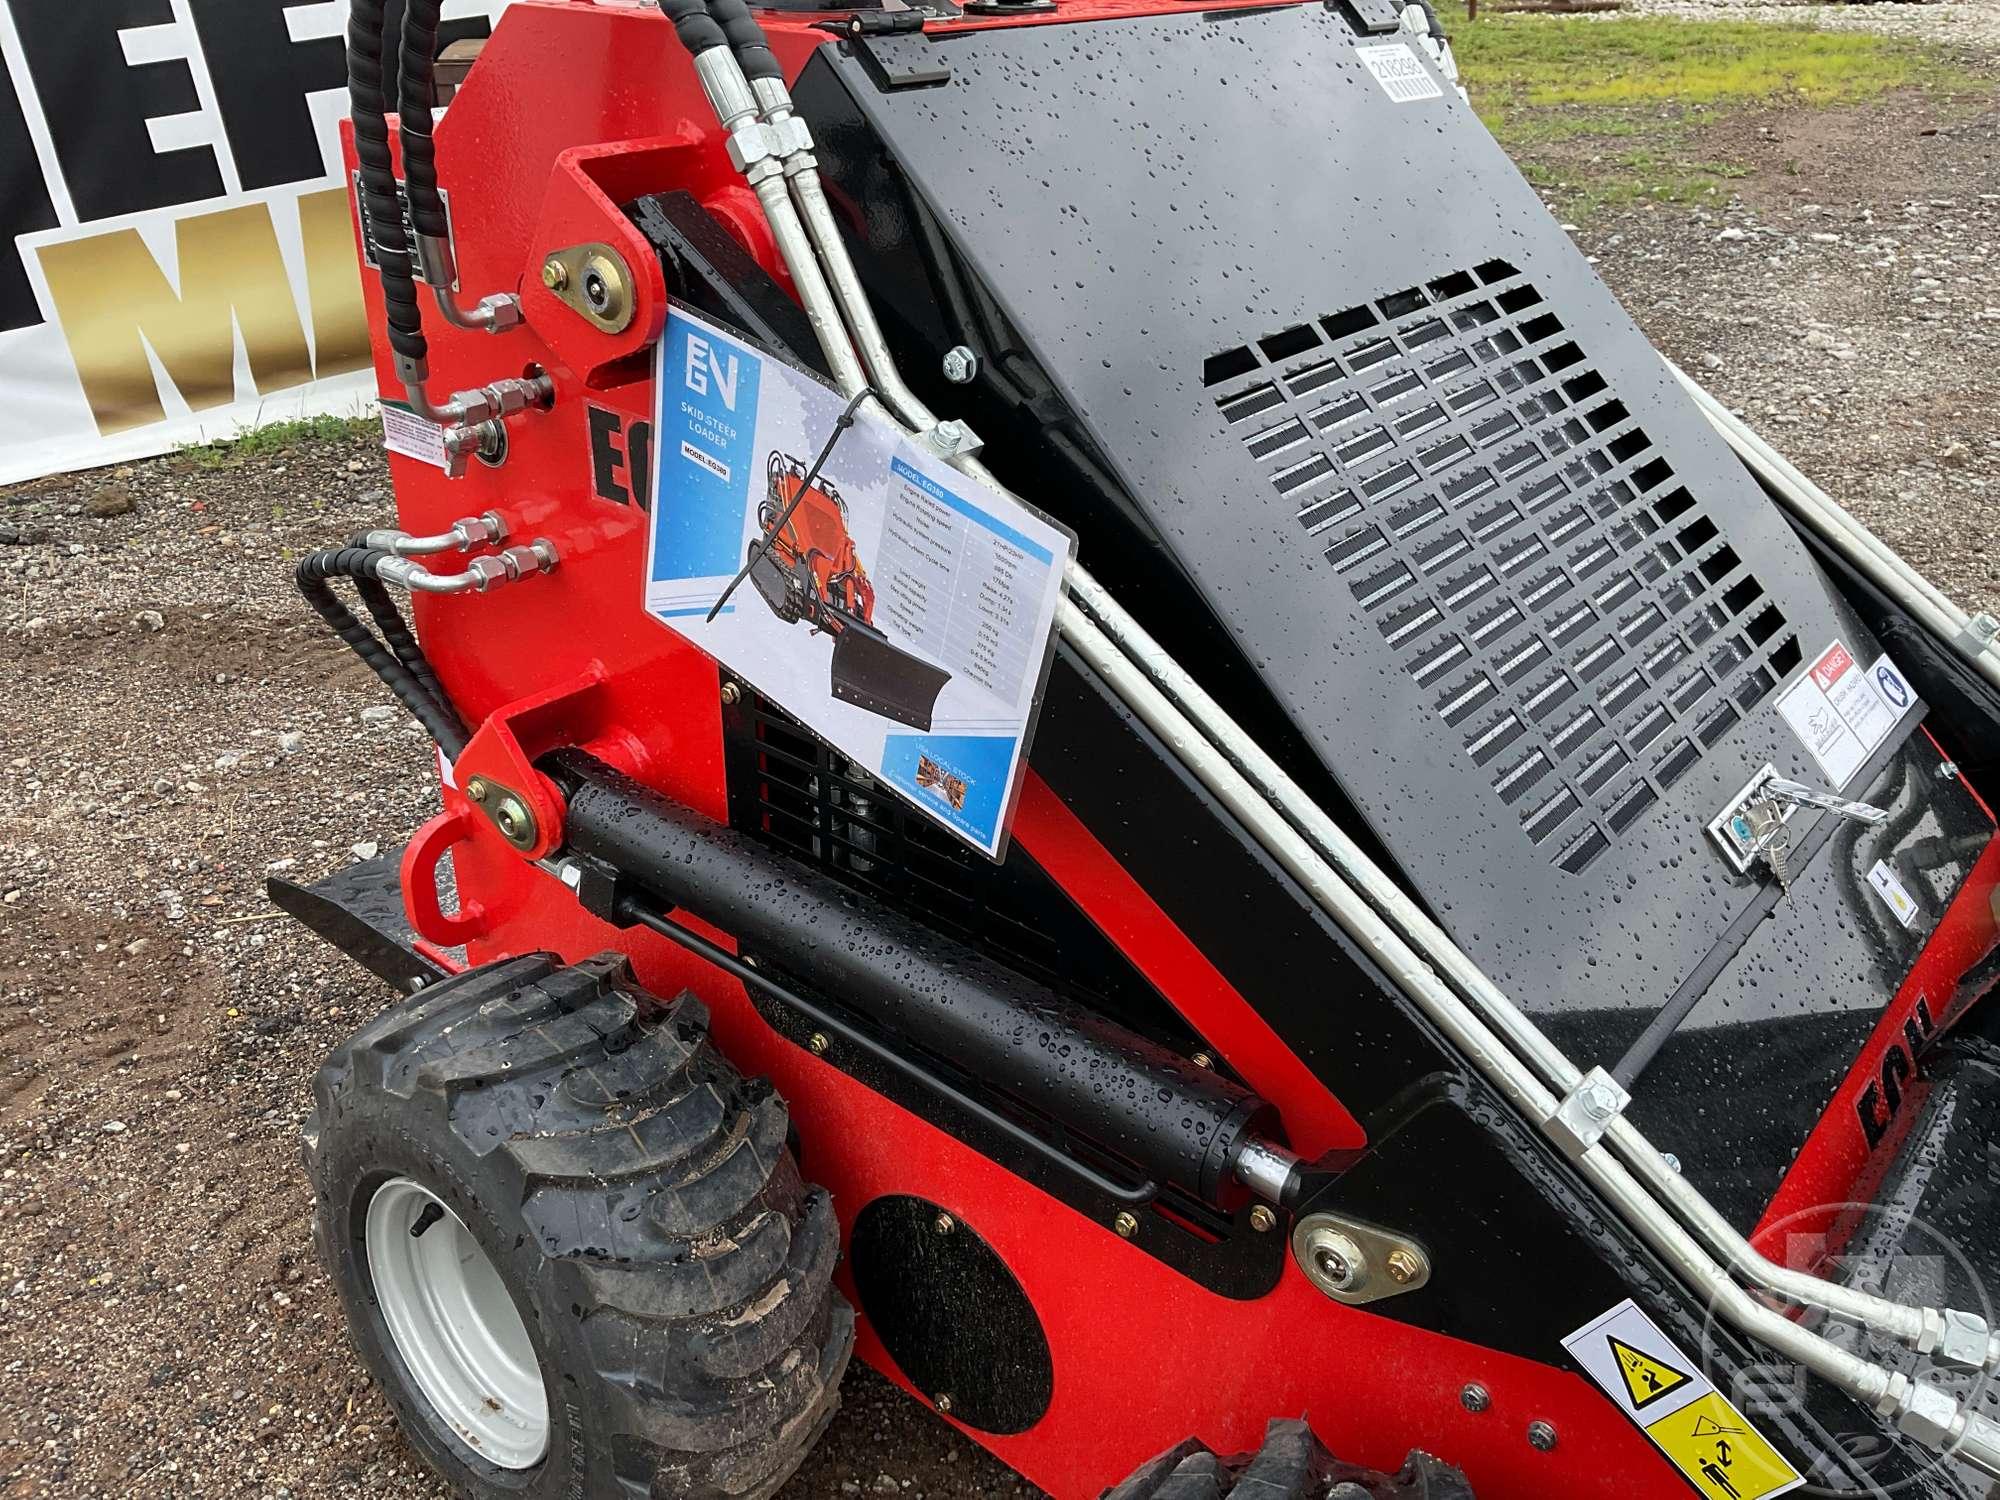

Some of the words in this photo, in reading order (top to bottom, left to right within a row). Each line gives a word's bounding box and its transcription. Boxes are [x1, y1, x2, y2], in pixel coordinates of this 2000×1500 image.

[681, 402, 704, 421] SKID
[705, 415, 737, 440] STEER
[689, 420, 727, 448] LOADER
[930, 751, 951, 770] LOCAL
[952, 766, 976, 786] STOCK
